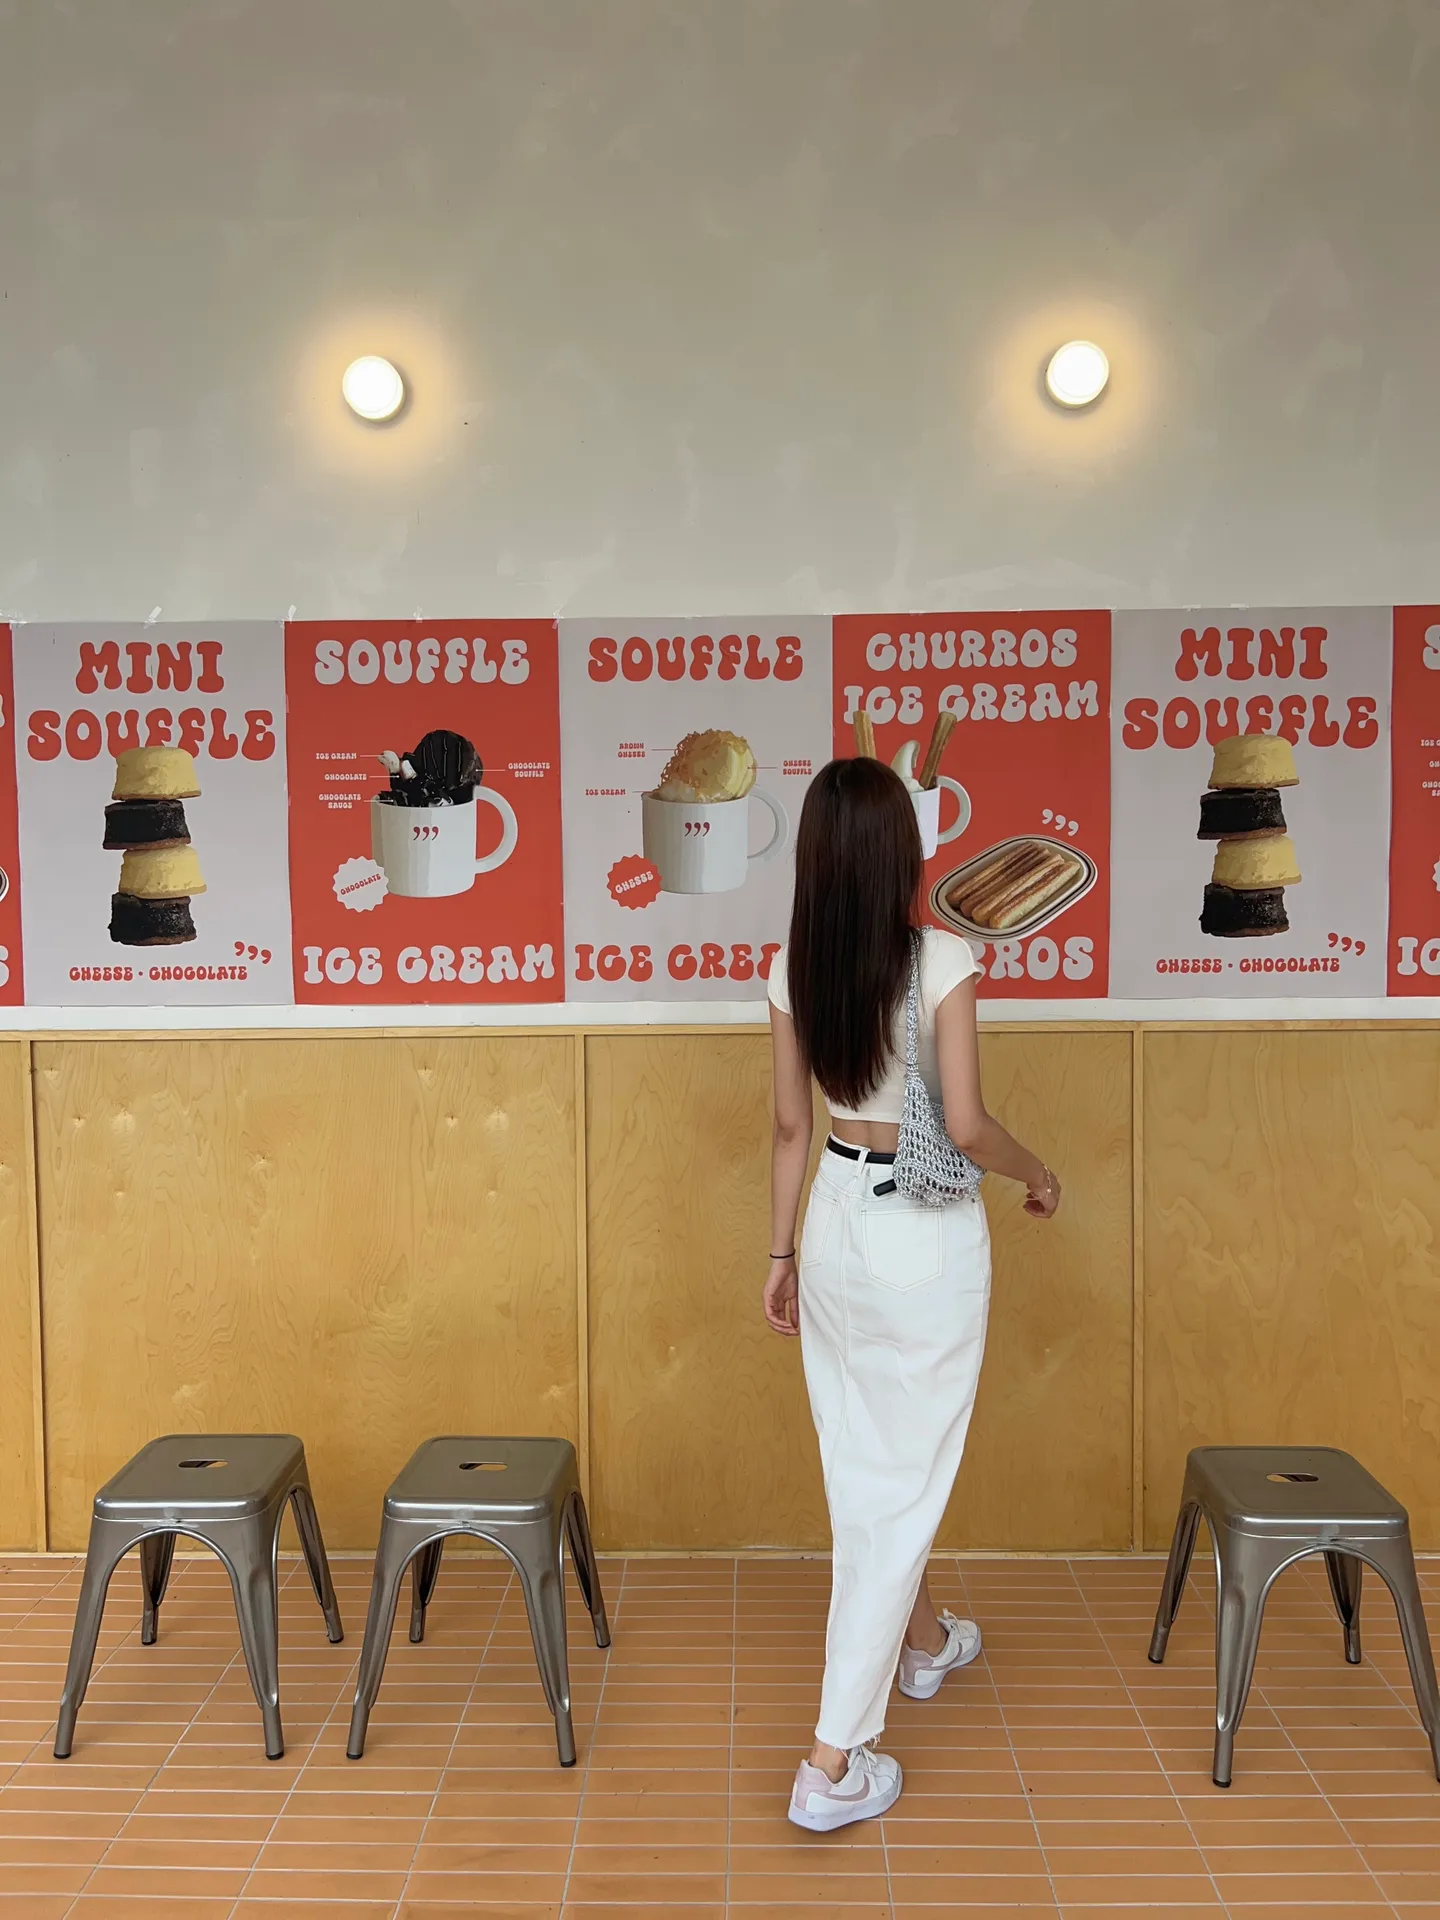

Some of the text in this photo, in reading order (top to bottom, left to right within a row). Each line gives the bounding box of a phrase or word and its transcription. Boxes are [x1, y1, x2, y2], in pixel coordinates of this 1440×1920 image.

[75, 640, 224, 695] MINI
[315, 637, 530, 686] SOUFFLE
[588, 635, 803, 683] SOUFFLE
[866, 629, 1077, 672] CHURROS
[1175, 626, 1328, 682] MINI
[843, 680, 1099, 725] ICE CREAM
[1122, 695, 1379, 751] SOUFFLE
[27, 708, 276, 762] SOUFFLE
[69, 965, 248, 982] CHEESE CHOCOLATE
[303, 943, 555, 985] ICE CREAM
[574, 942, 781, 982] ICE CREA
[1155, 957, 1341, 974] CHEESE CHOCOLATE
[1397, 936, 1440, 977] IC
